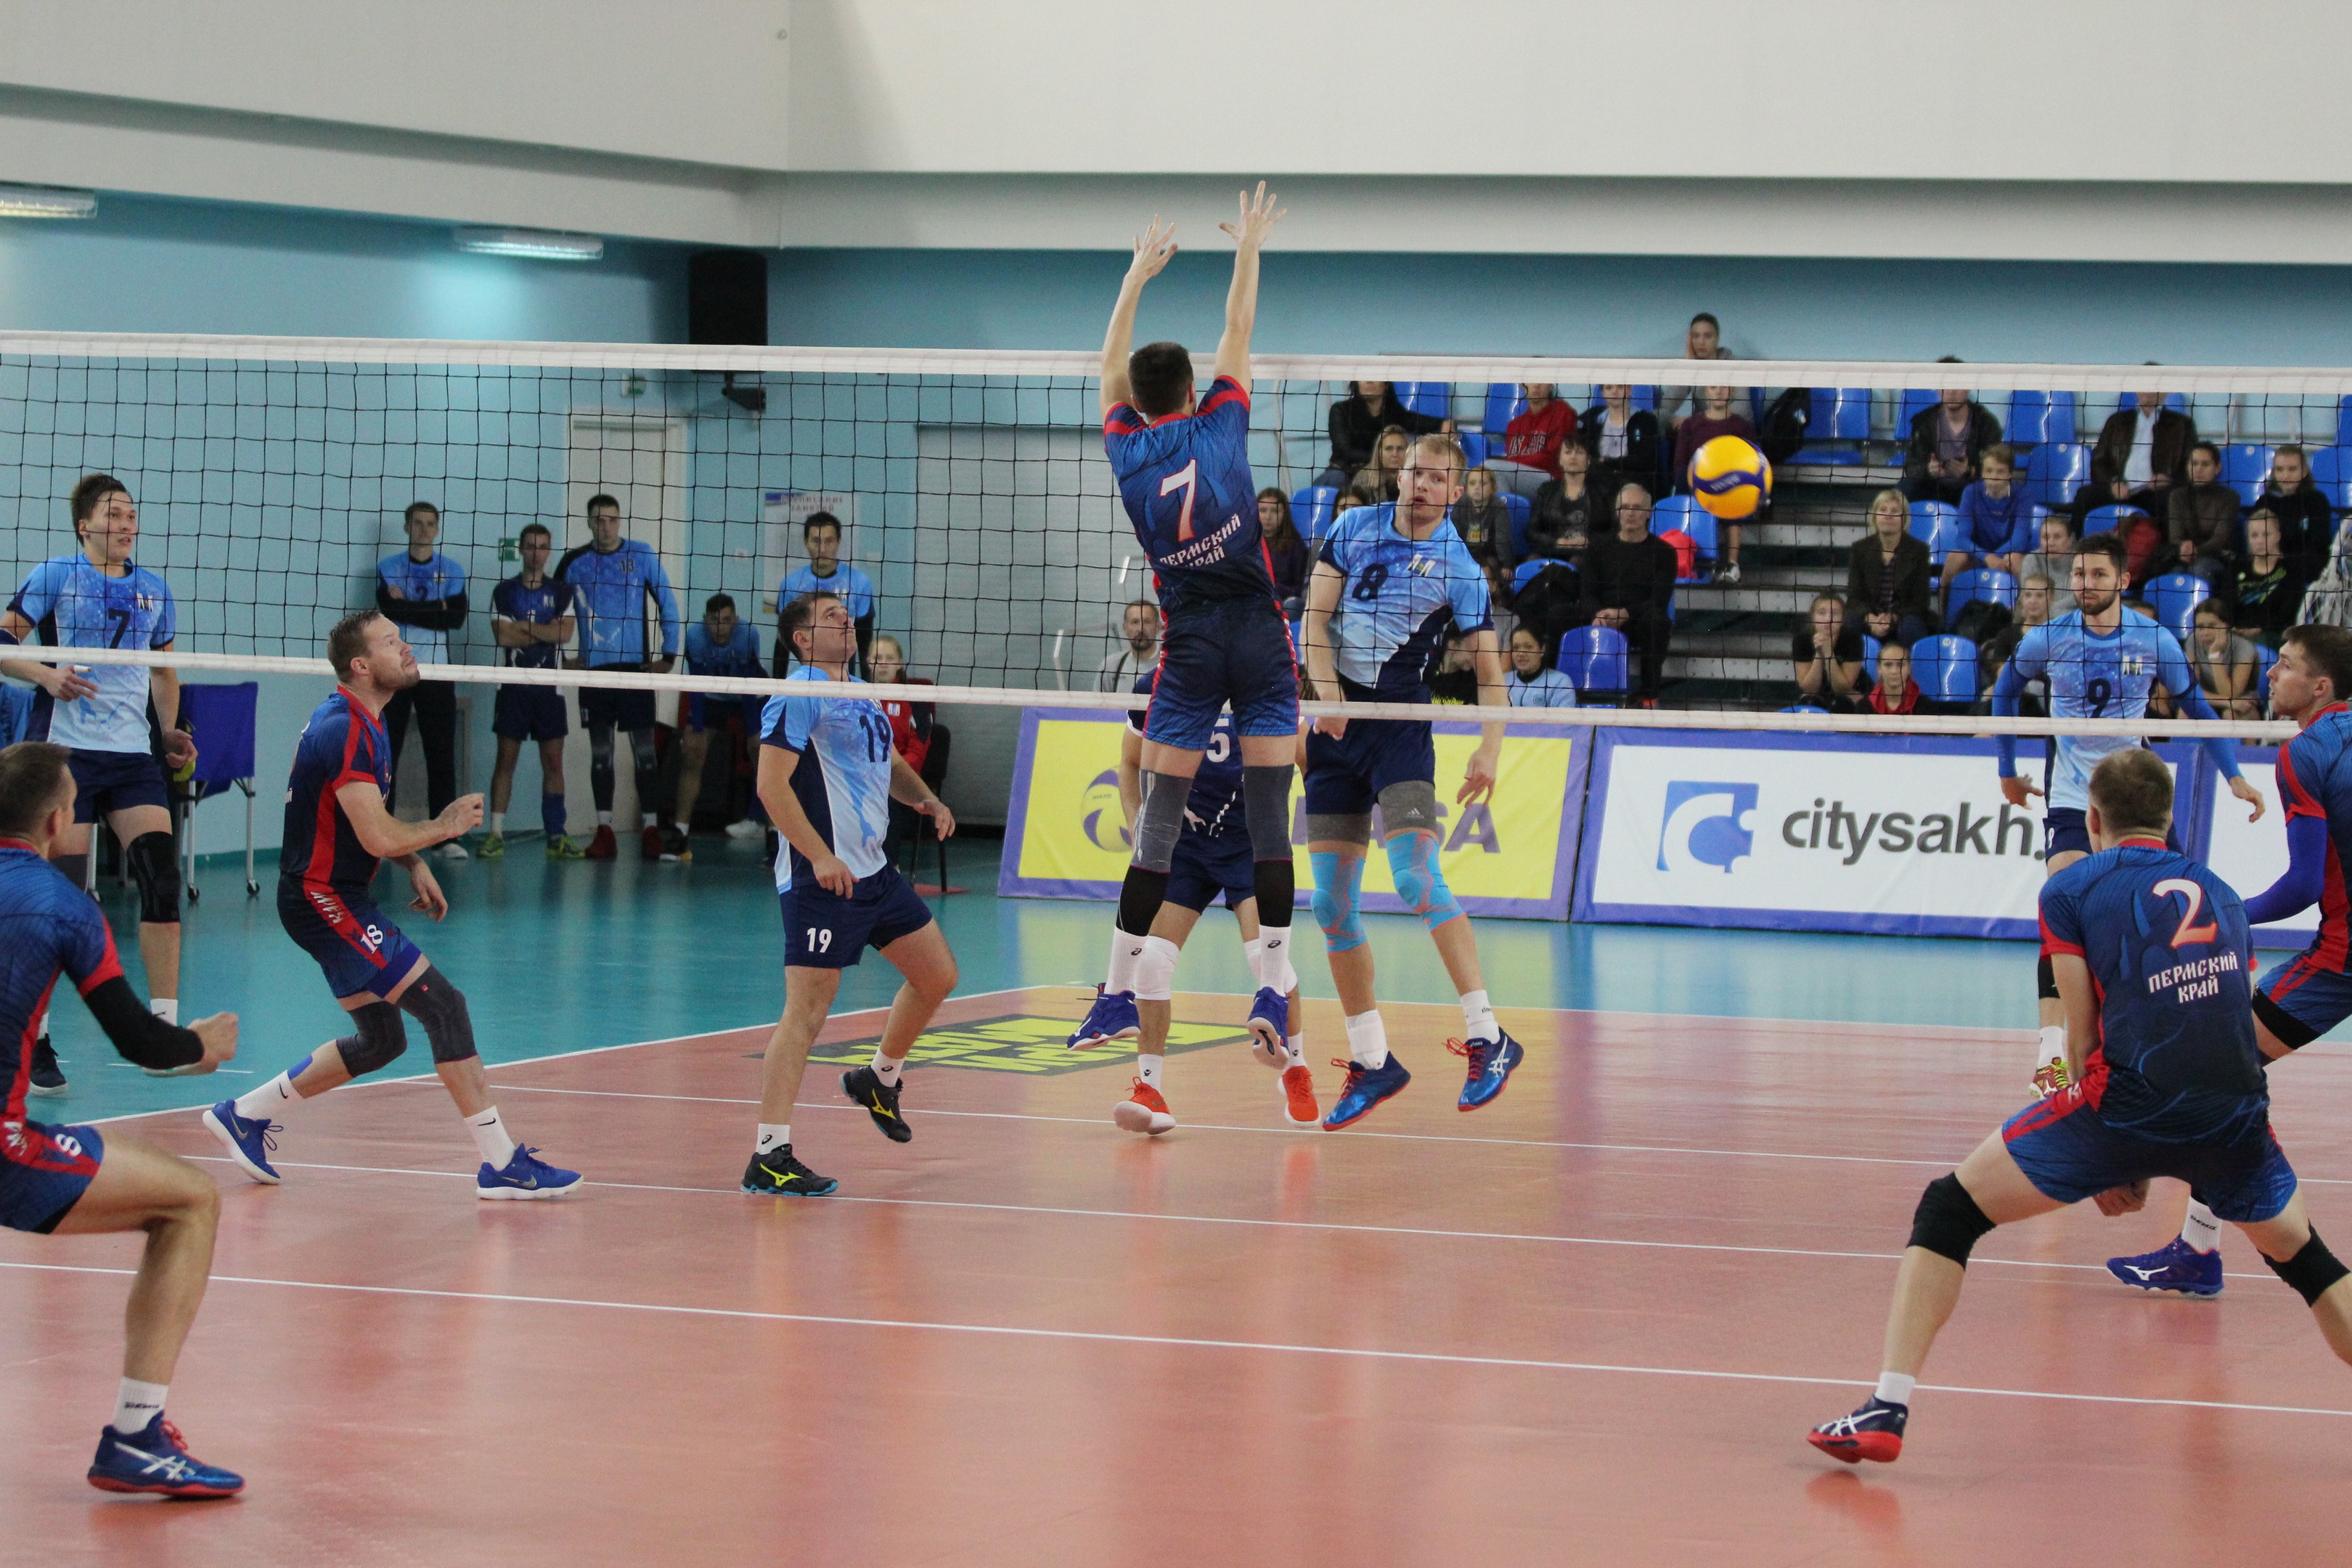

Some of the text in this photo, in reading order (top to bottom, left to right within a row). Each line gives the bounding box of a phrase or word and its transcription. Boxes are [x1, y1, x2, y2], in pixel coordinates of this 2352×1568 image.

[1159, 457, 1197, 543] 7
[1185, 545, 1226, 568] РАЙ
[1352, 563, 1389, 602] 8
[107, 608, 131, 649] 7
[2087, 677, 2112, 718] 9
[859, 714, 891, 763] 19
[2151, 878, 2219, 950] 2
[360, 923, 384, 955] 18
[807, 927, 833, 953] 19
[2148, 951, 2239, 994] ПЕРМСКИЙ
[2178, 975, 2220, 1004] КРАЙ
[54, 1133, 83, 1158] 8
